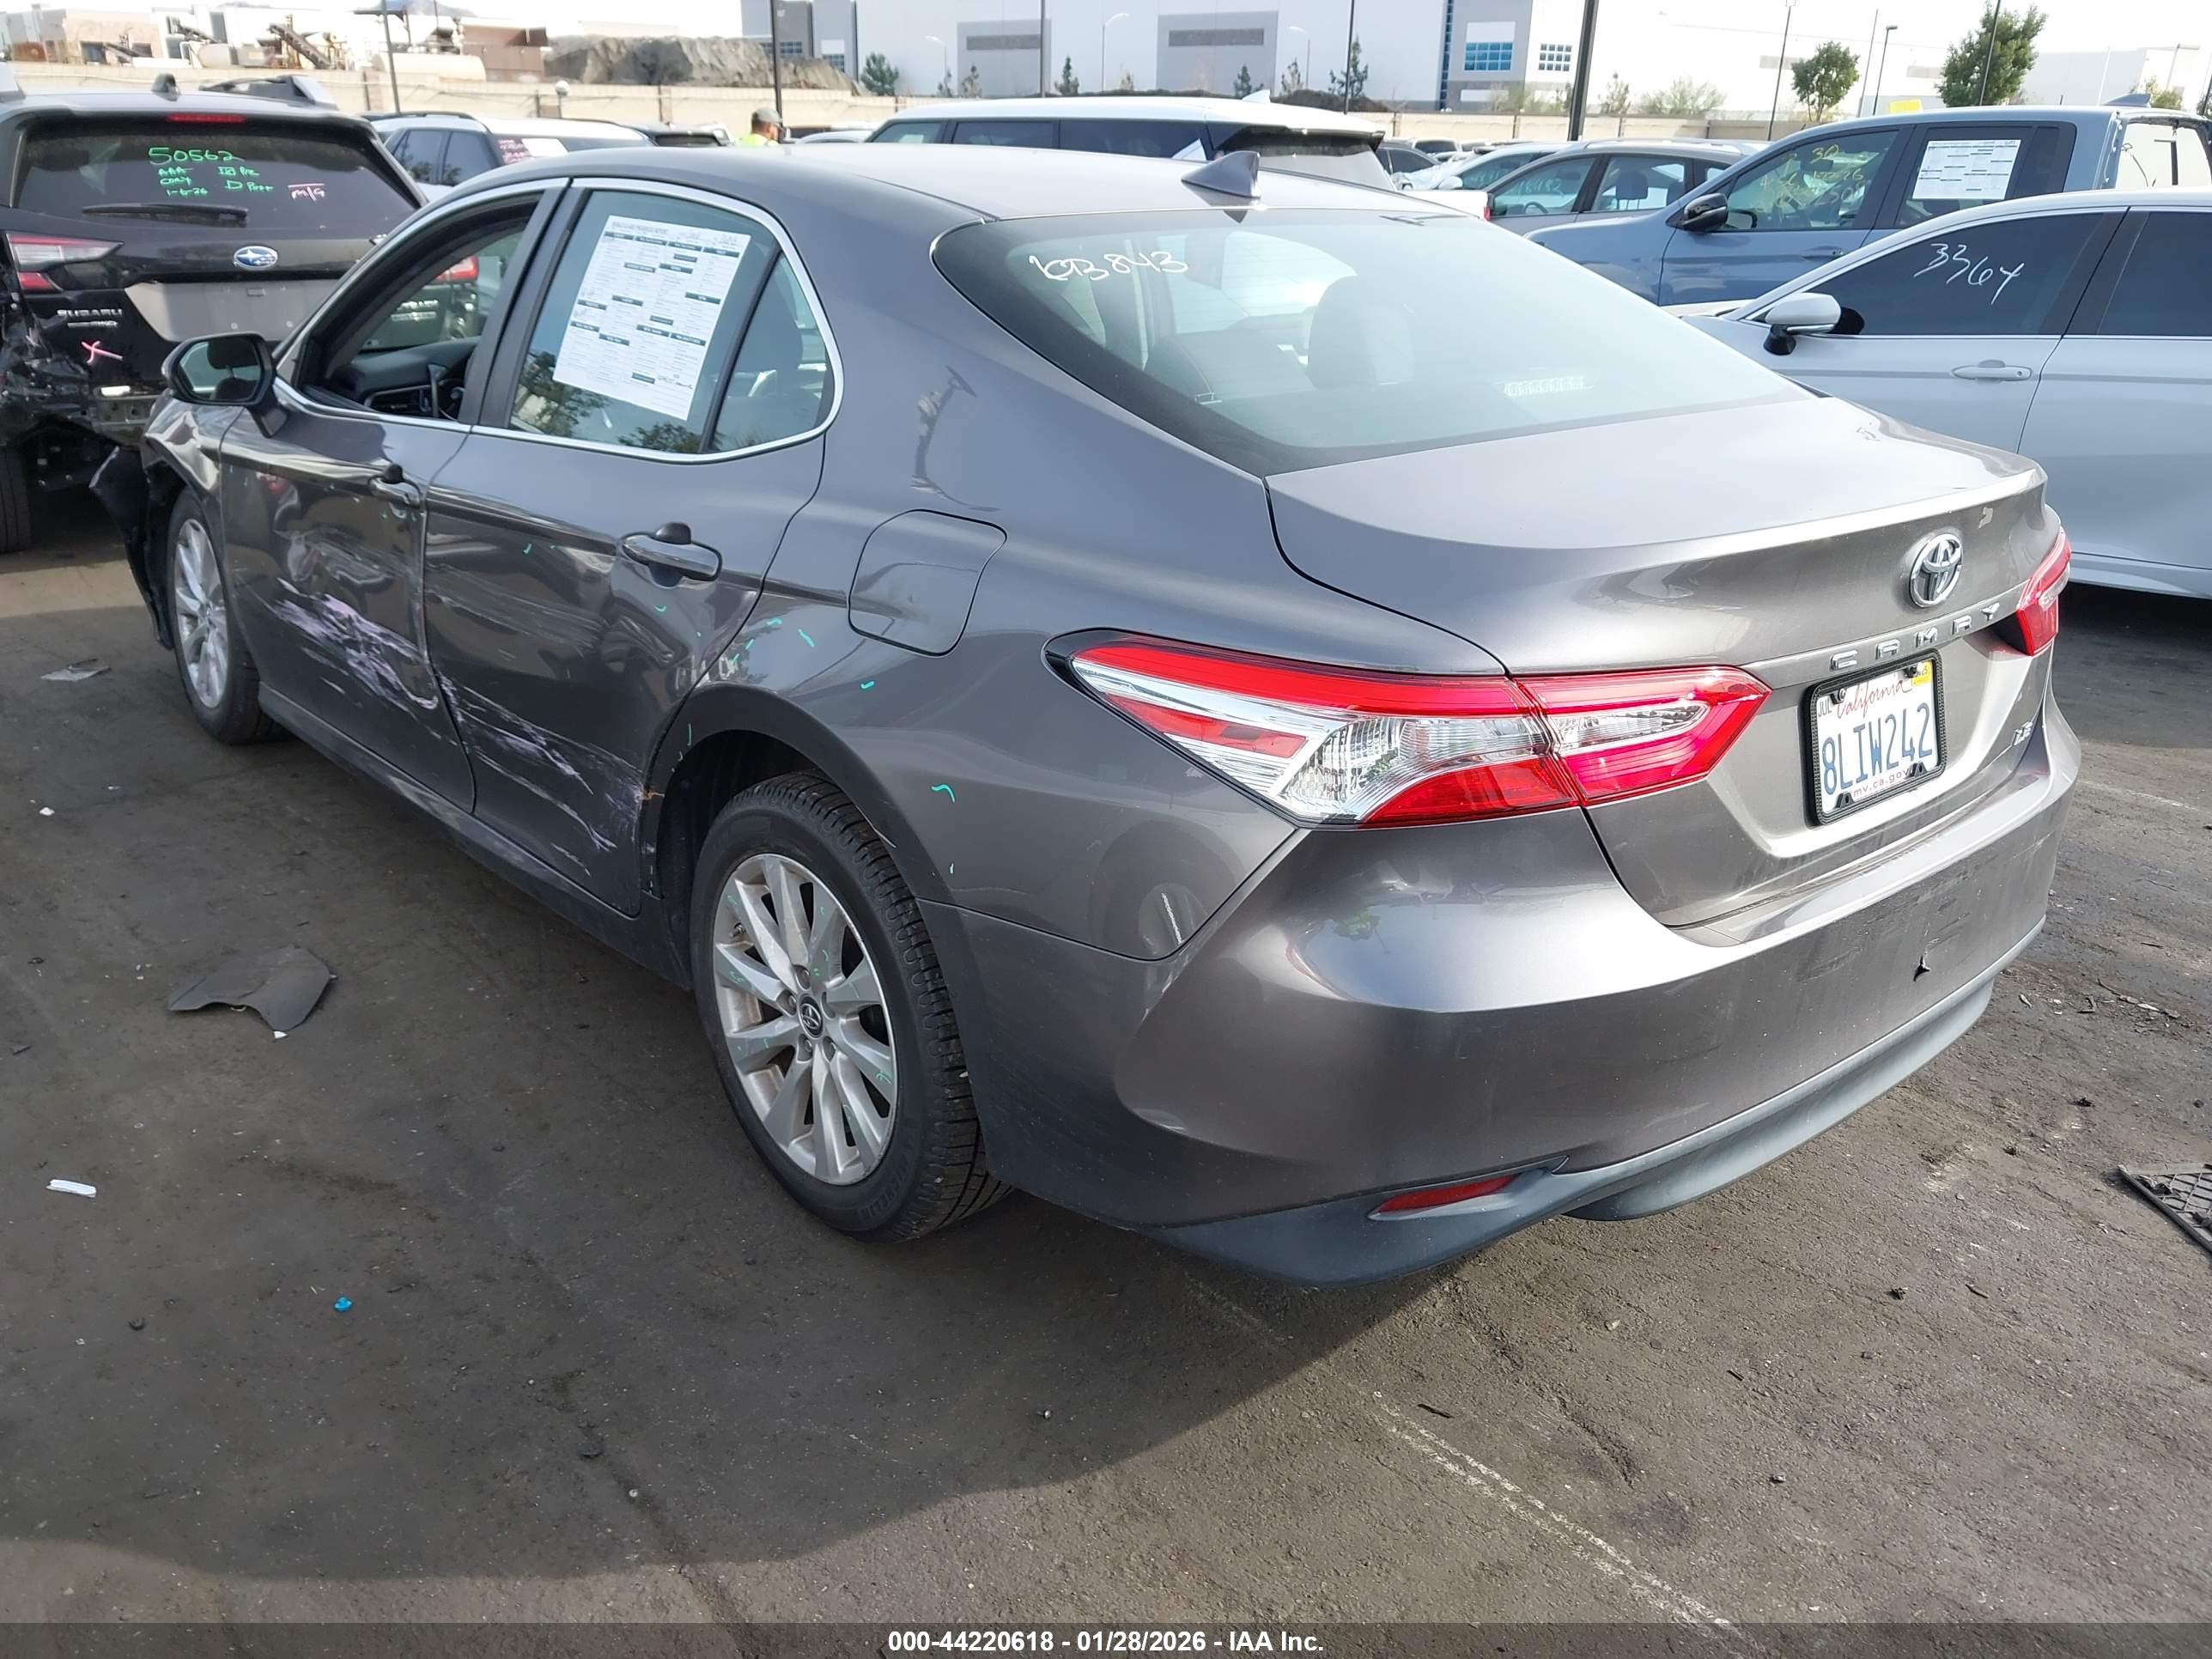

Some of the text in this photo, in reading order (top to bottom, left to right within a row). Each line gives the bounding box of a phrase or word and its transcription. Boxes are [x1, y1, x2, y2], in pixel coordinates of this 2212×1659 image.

[149, 147, 245, 165] 50562
[1913, 243, 2025, 306] 3364
[1830, 602, 2000, 671] CAMRY
[1836, 676, 1913, 720] California
[1821, 702, 1933, 796] 8LIW242
[1850, 768, 1913, 799] mv.ca.gov
